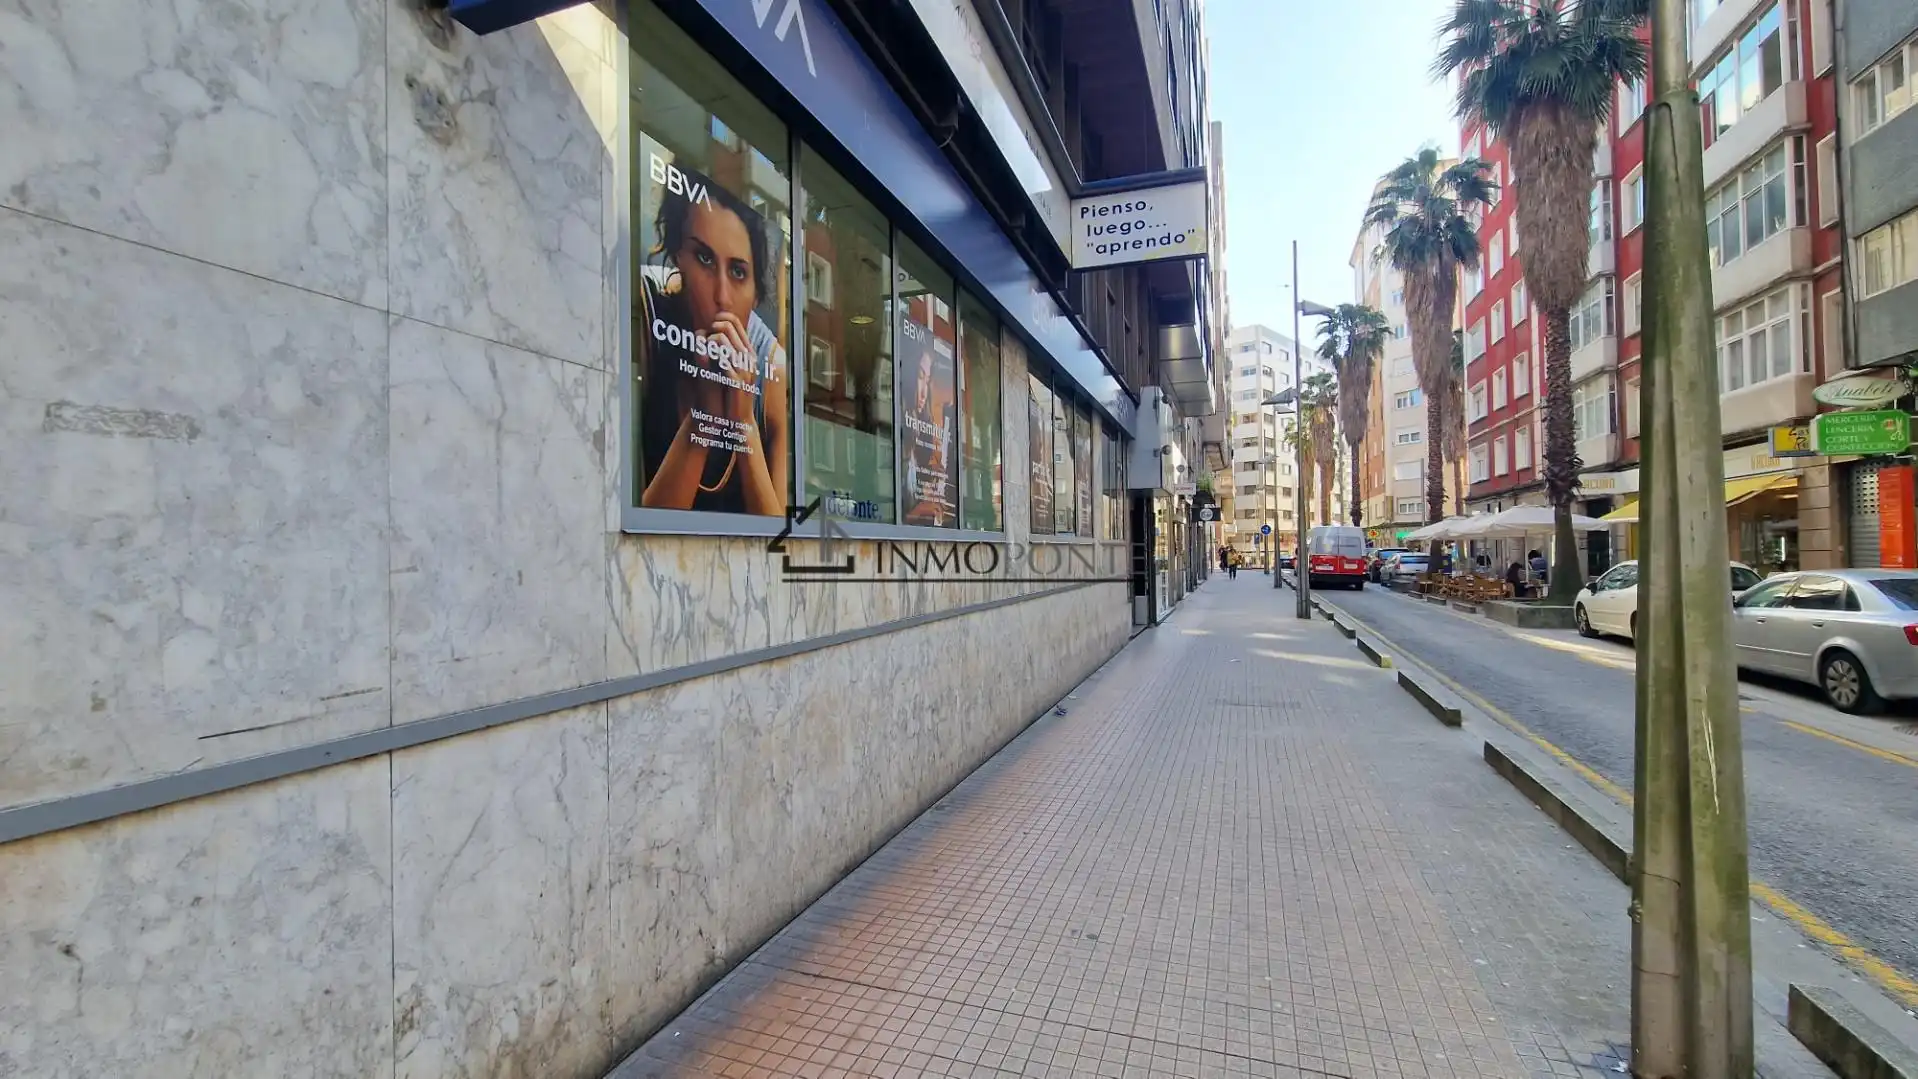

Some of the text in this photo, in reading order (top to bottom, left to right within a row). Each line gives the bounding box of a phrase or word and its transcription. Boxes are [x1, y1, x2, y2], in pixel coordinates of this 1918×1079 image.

[650, 151, 713, 213] BBVA
[1080, 200, 1153, 219] Pienso,
[1087, 220, 1167, 237] luego...
[1087, 229, 1195, 255] "aprendo"
[903, 318, 926, 345] BBVA
[652, 318, 761, 376] conseguir.
[679, 358, 699, 378] Hoy
[699, 366, 741, 390] comienza
[690, 407, 713, 423] Valora
[714, 415, 729, 426] casa
[730, 419, 735, 428] y
[690, 433, 724, 449] Programa
[699, 423, 722, 437] Gestor
